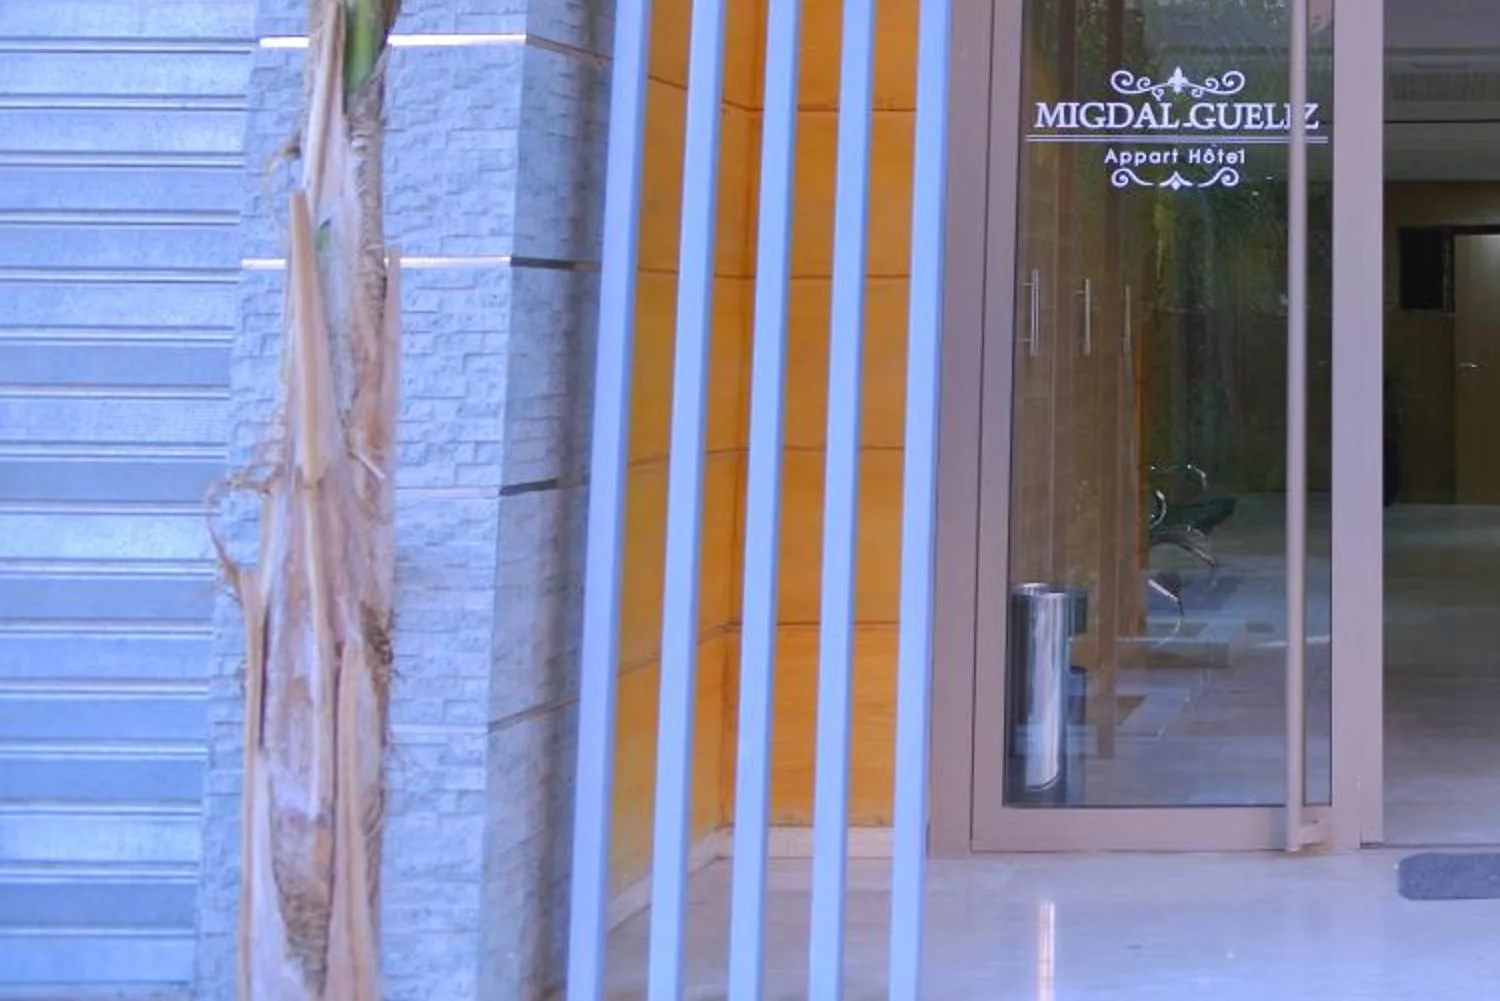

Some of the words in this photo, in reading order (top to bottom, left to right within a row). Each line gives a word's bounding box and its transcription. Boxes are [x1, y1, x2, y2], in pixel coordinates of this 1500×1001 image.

[1032, 101, 1181, 129] MIGDAL
[1103, 147, 1180, 167] Appart
[1187, 146, 1246, 165] Hôtel
